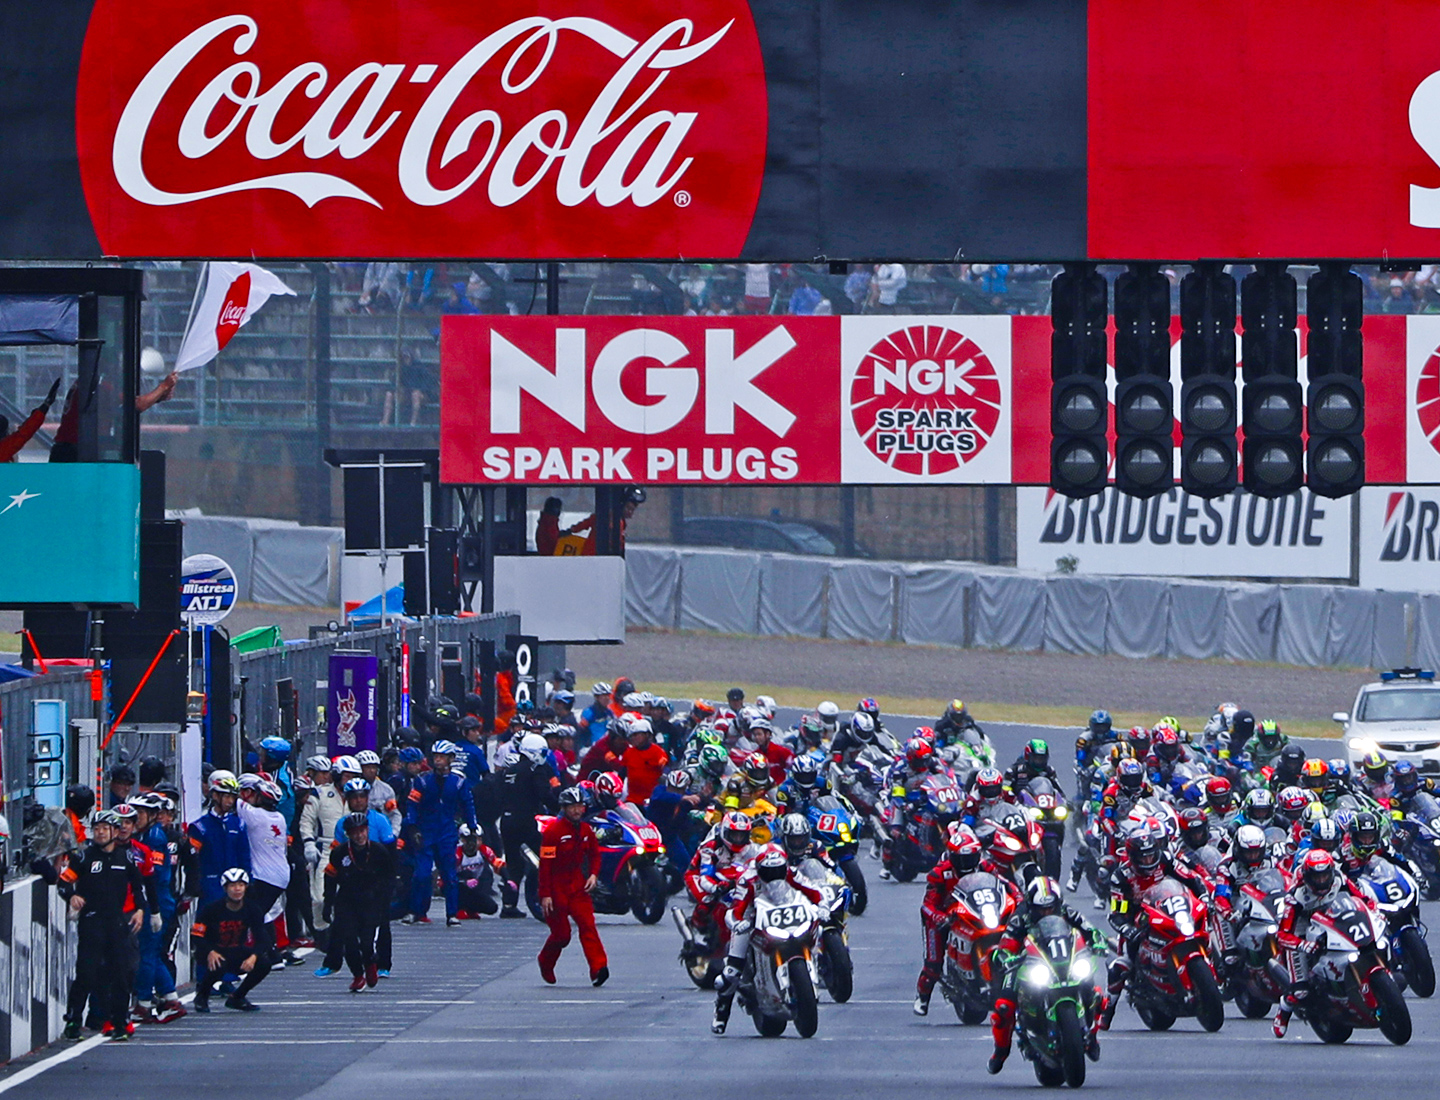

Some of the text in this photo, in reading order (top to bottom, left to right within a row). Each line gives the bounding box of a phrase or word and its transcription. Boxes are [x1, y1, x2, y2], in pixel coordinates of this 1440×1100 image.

[113, 15, 735, 210] Coca-Cola
[489, 323, 797, 439] NGK
[873, 357, 978, 396] NGK
[877, 408, 974, 431] SPARK
[877, 431, 975, 453] PLUGS
[482, 446, 799, 481] SPARK PLUGS
[1039, 487, 1326, 547] BRIDGESTONE
[182, 584, 234, 594] Mistresa
[187, 595, 223, 611] ATJ
[1037, 794, 1055, 808] 87
[823, 816, 832, 830] 9
[1006, 814, 1025, 830] 23
[973, 889, 995, 905] 95
[1386, 883, 1403, 901] 5
[1163, 895, 1187, 915] 12
[770, 906, 806, 926] 634
[1349, 922, 1370, 942] 21
[1048, 938, 1068, 959] 11
